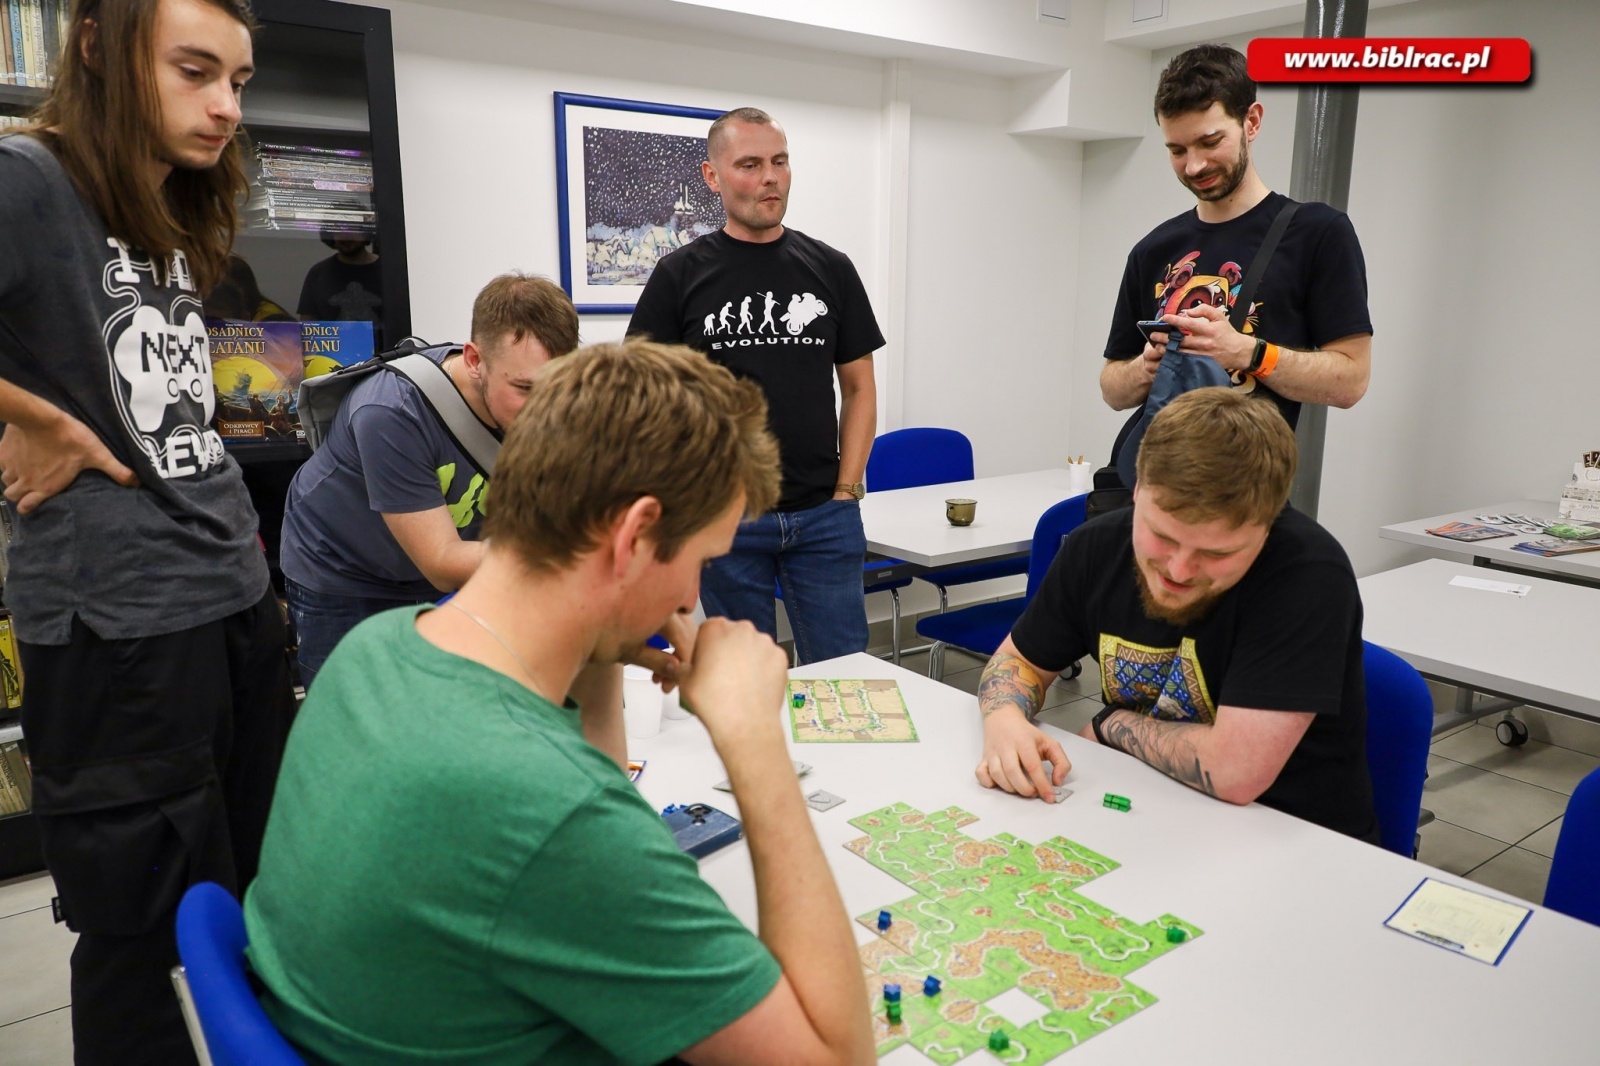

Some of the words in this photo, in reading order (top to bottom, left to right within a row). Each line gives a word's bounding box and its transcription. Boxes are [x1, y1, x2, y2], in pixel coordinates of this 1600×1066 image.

[302, 326, 340, 336] DNICY
[711, 337, 826, 350] EVOLUTION
[140, 331, 208, 375] NEXT
